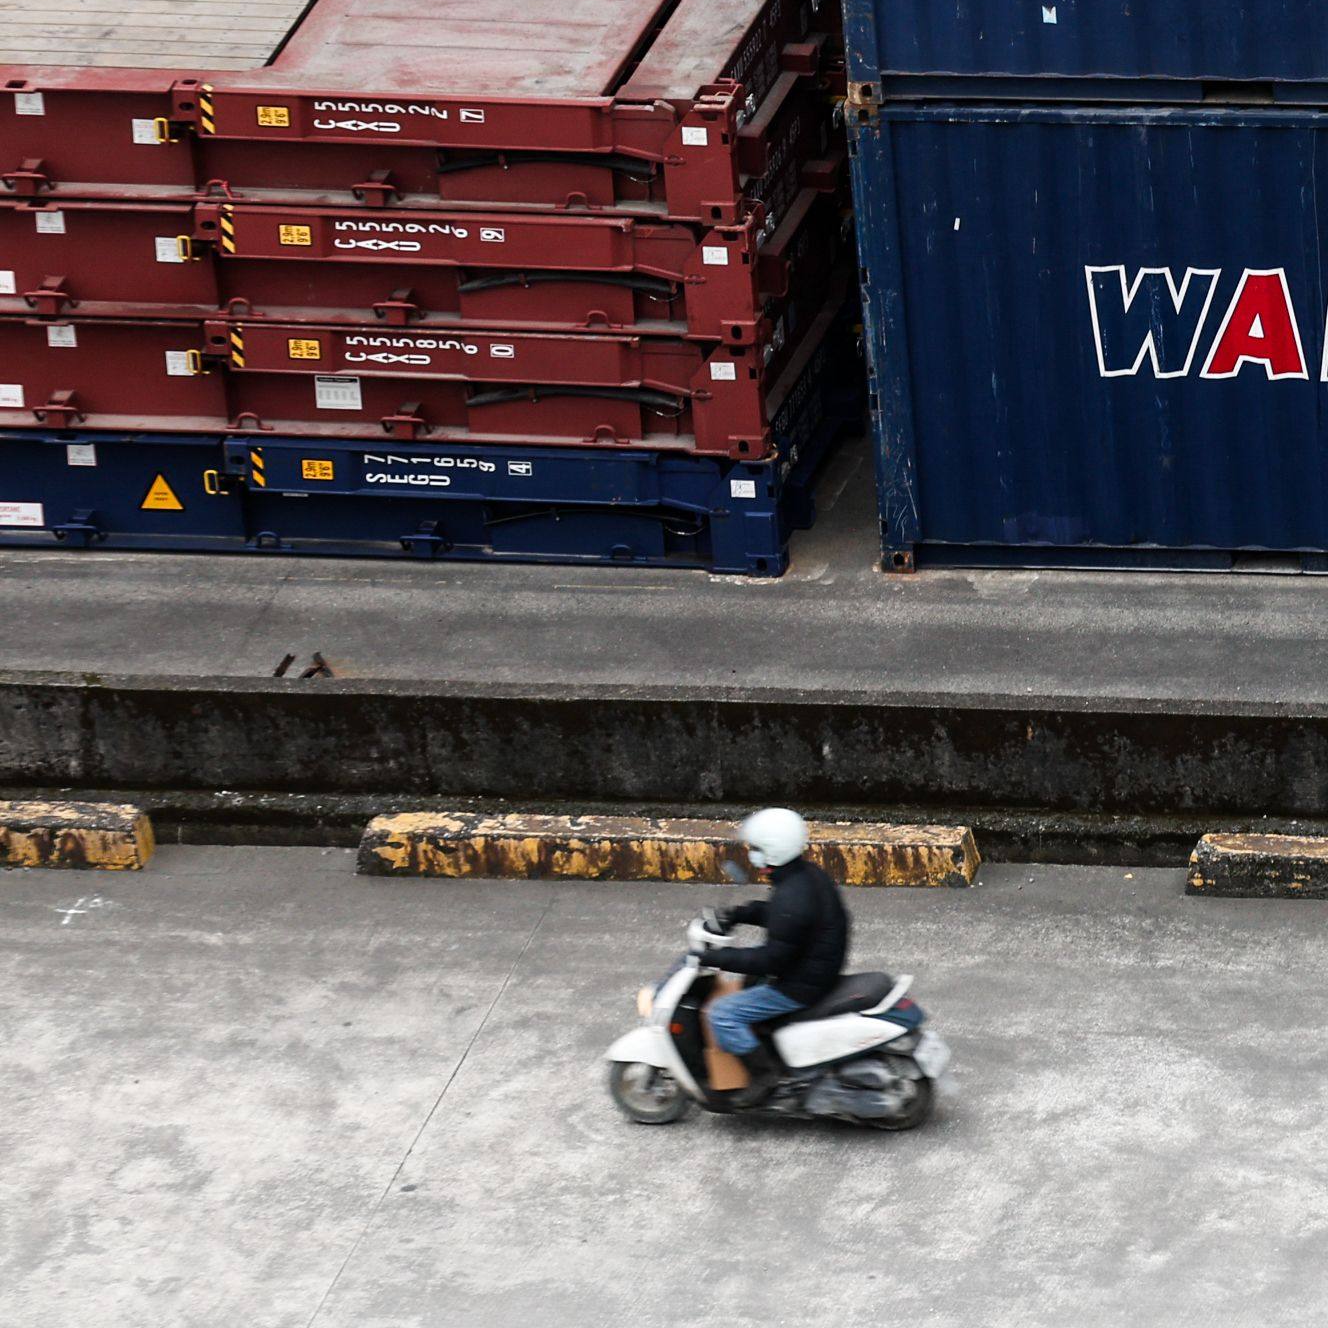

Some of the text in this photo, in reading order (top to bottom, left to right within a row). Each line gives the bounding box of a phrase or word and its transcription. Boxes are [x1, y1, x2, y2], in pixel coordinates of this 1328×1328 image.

[315, 101, 448, 120] 555922
[314, 119, 401, 133] CAXU
[335, 221, 468, 239] 555926
[334, 238, 421, 252] CAXU
[345, 351, 431, 366] CAXU
[364, 454, 496, 473] 771659
[366, 472, 451, 487] SEGU
